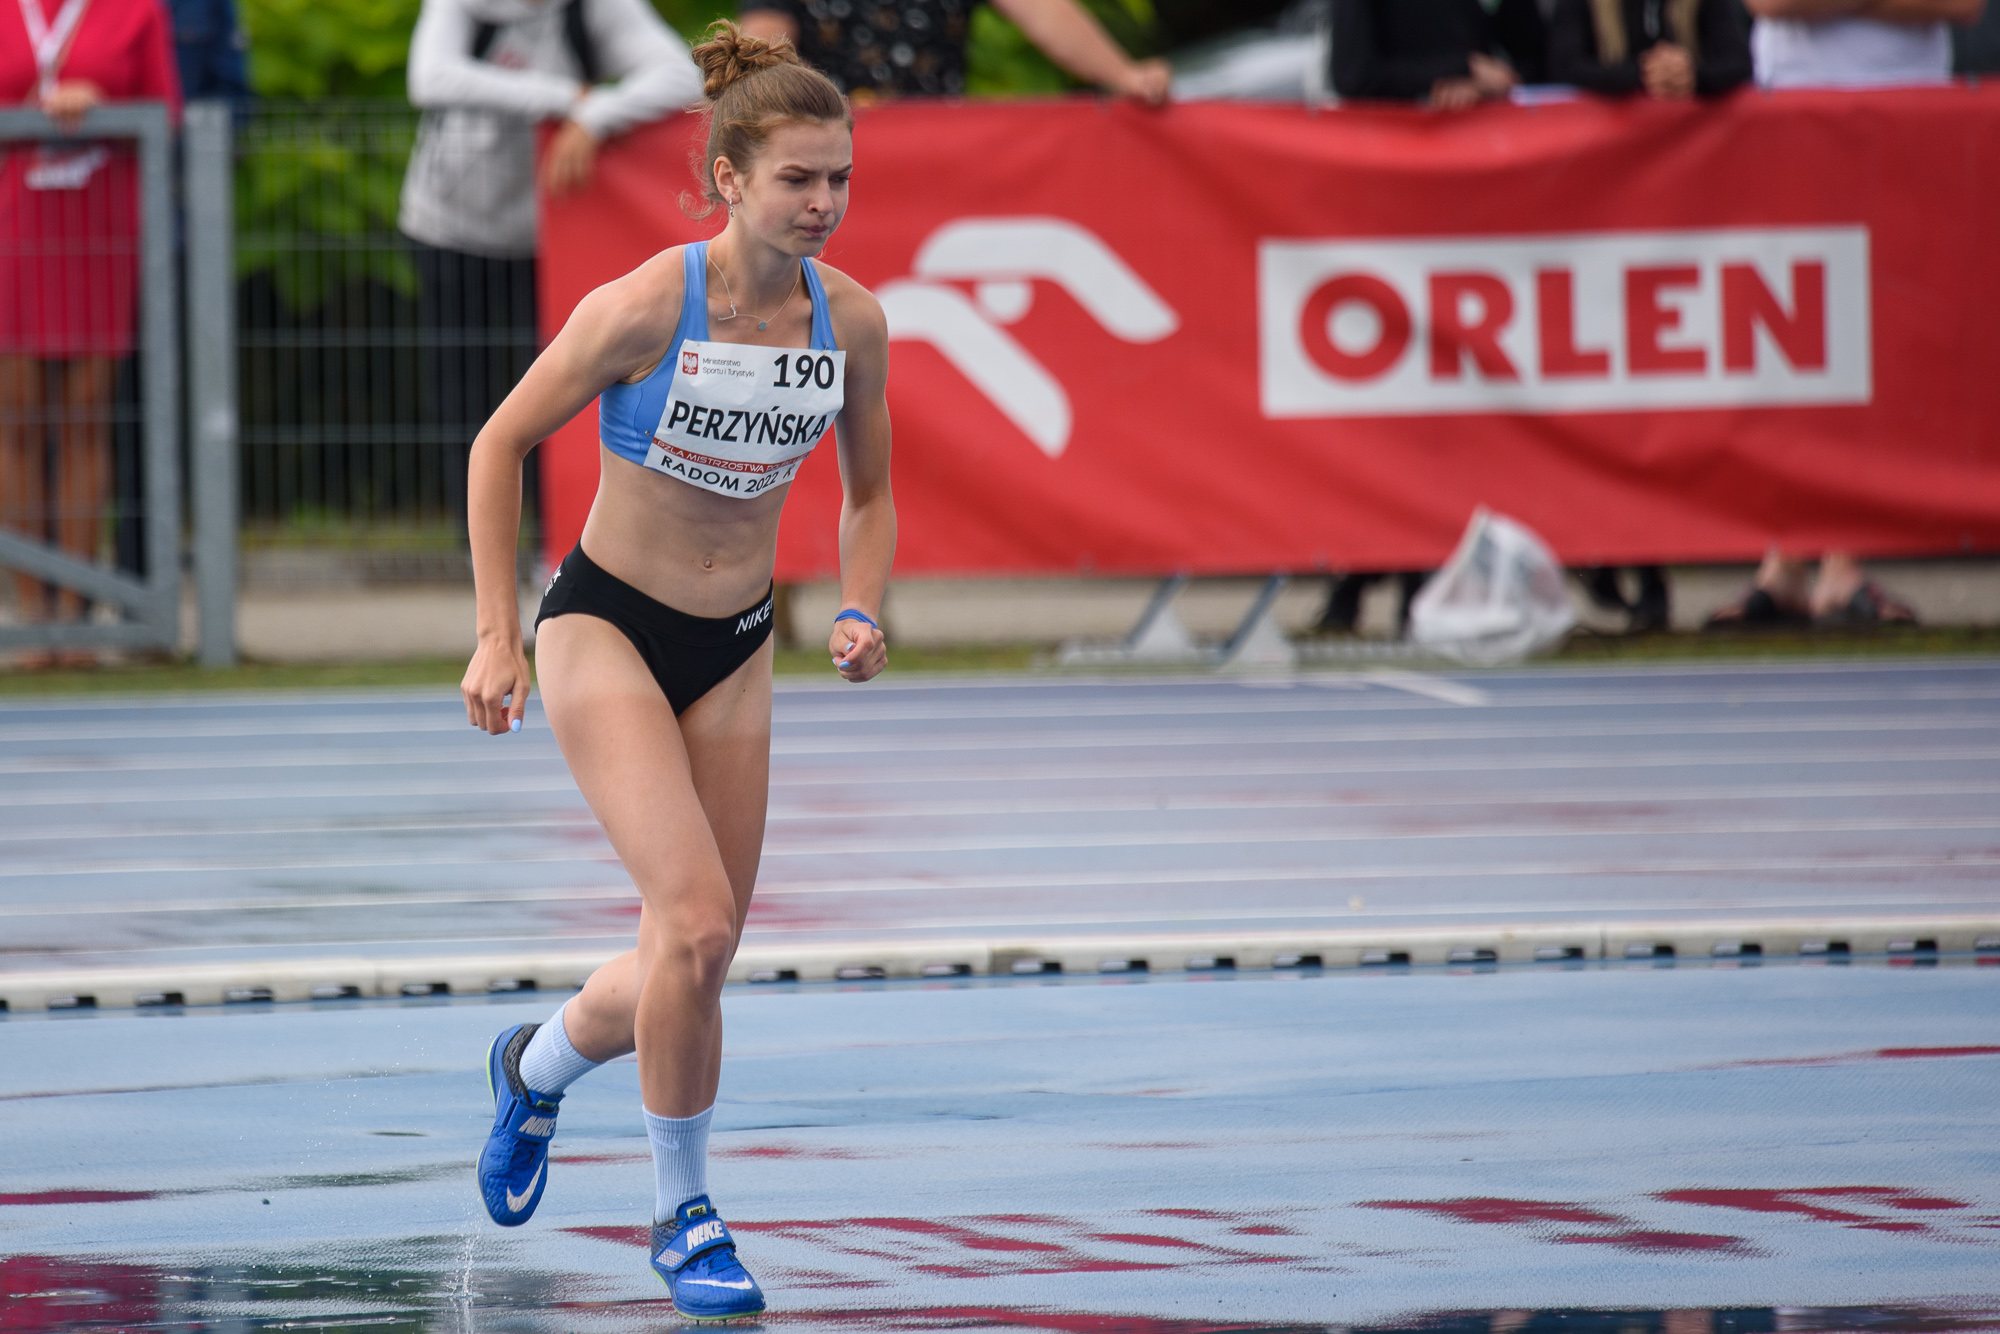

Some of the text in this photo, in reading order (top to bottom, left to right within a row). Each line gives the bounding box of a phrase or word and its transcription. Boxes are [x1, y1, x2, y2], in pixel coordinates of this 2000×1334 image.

[1295, 259, 1828, 385] ORLEN
[702, 357, 741, 367] Ministerstwo
[702, 366, 723, 375] Sportu
[727, 368, 755, 378] Turystyki
[773, 354, 835, 390] 190
[667, 400, 828, 446] PERZYŃSKA
[661, 455, 740, 491] RADOM
[744, 471, 779, 493] 2022
[687, 453, 764, 473] MISTRZOSTWA
[735, 599, 771, 635] NIKE
[686, 1221, 724, 1252] NIKE
